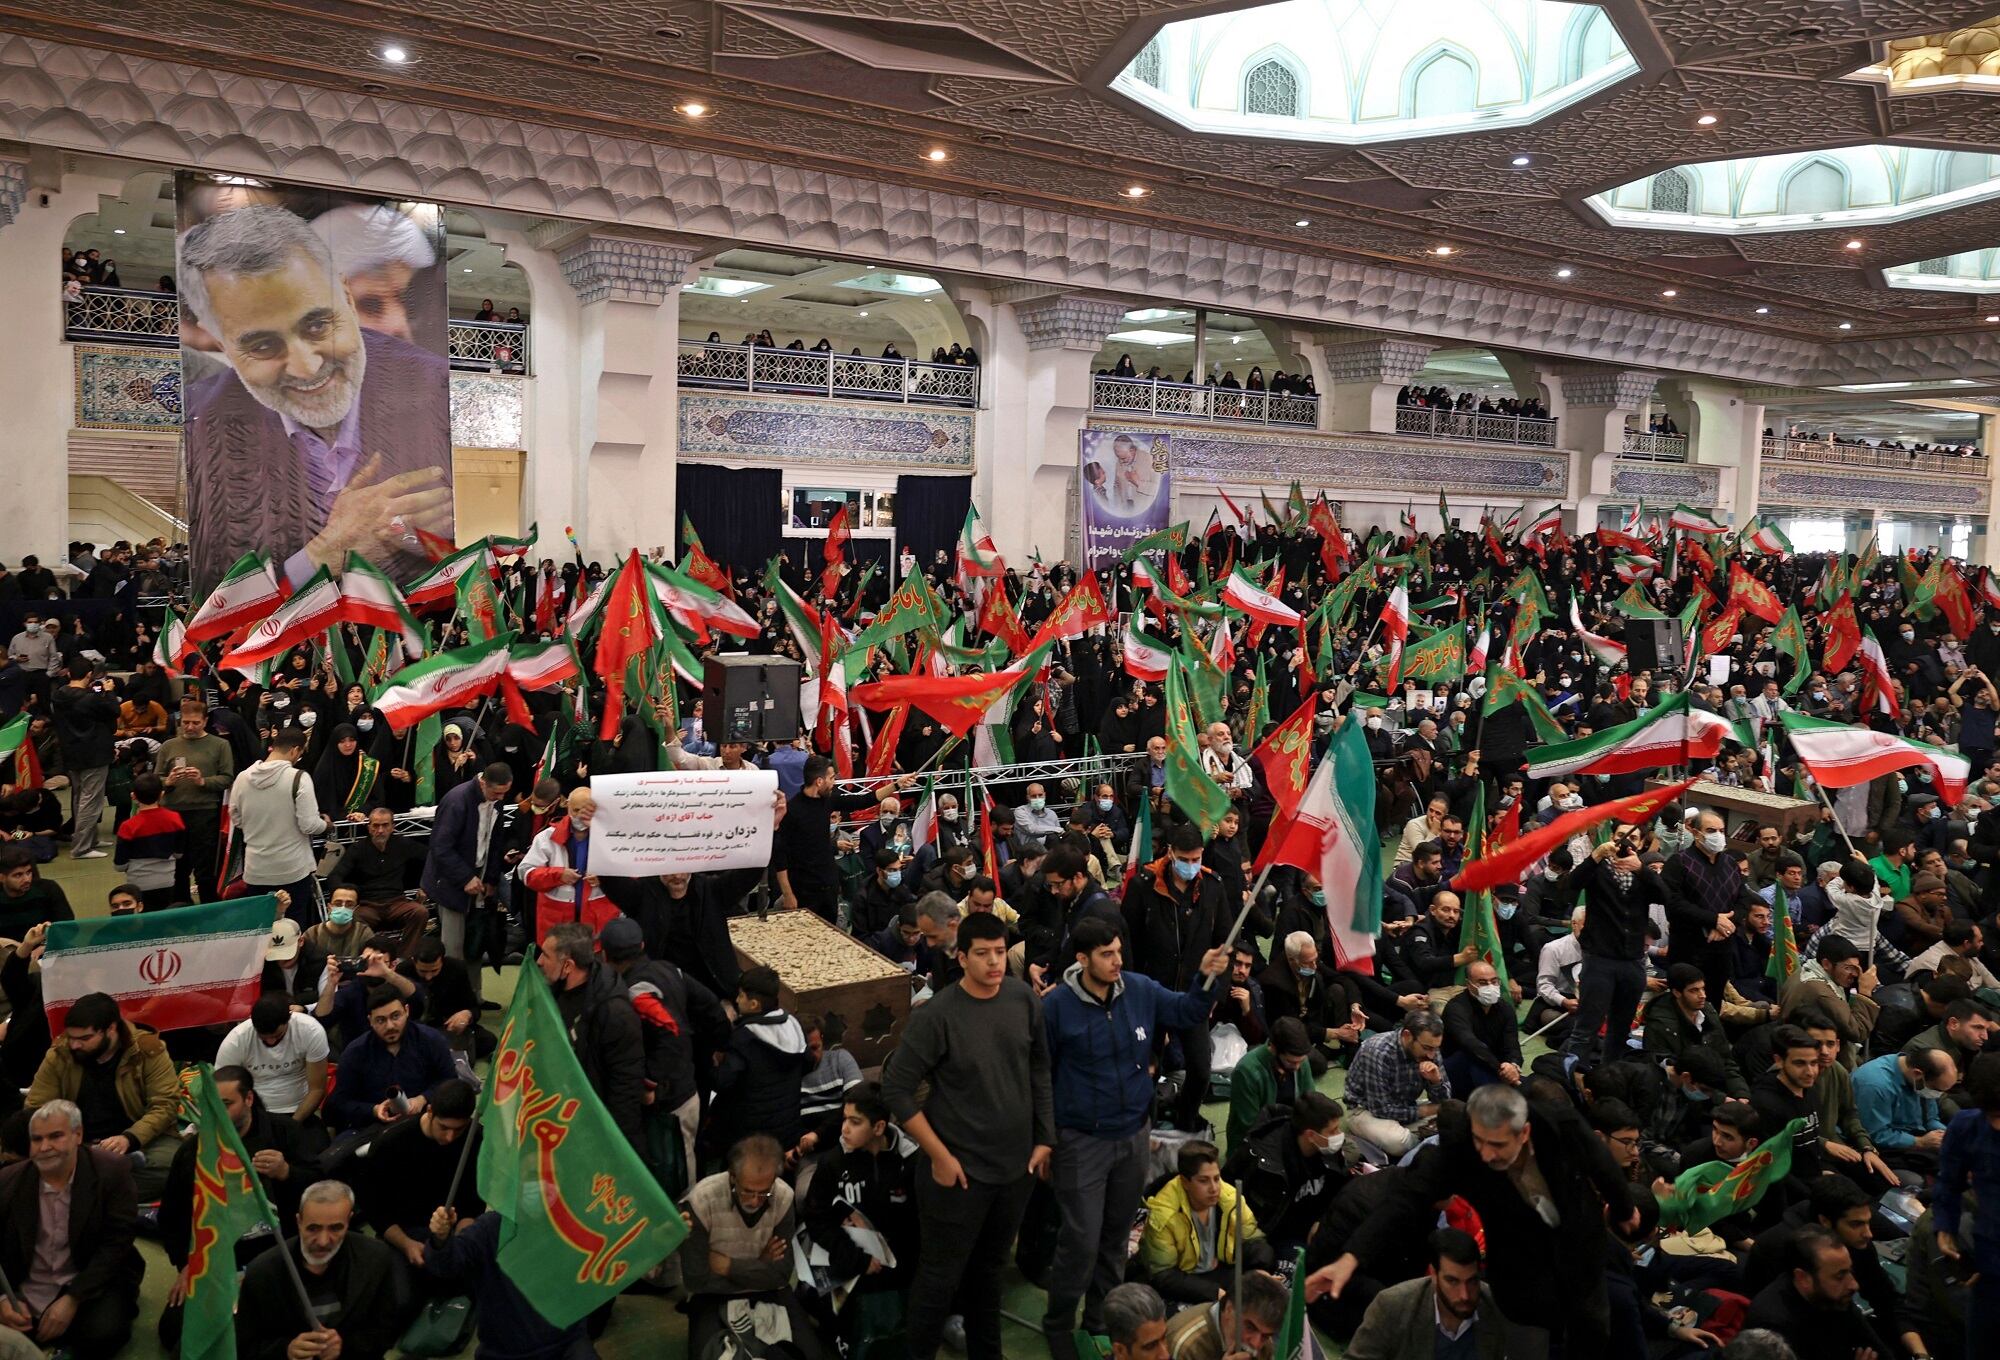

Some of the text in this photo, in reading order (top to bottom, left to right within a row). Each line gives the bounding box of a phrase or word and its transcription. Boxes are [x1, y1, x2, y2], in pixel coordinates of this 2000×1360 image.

[1088, 524, 1113, 538] شهدا
[1113, 524, 1151, 538] فرزندان
[725, 825, 758, 839] دزدان
